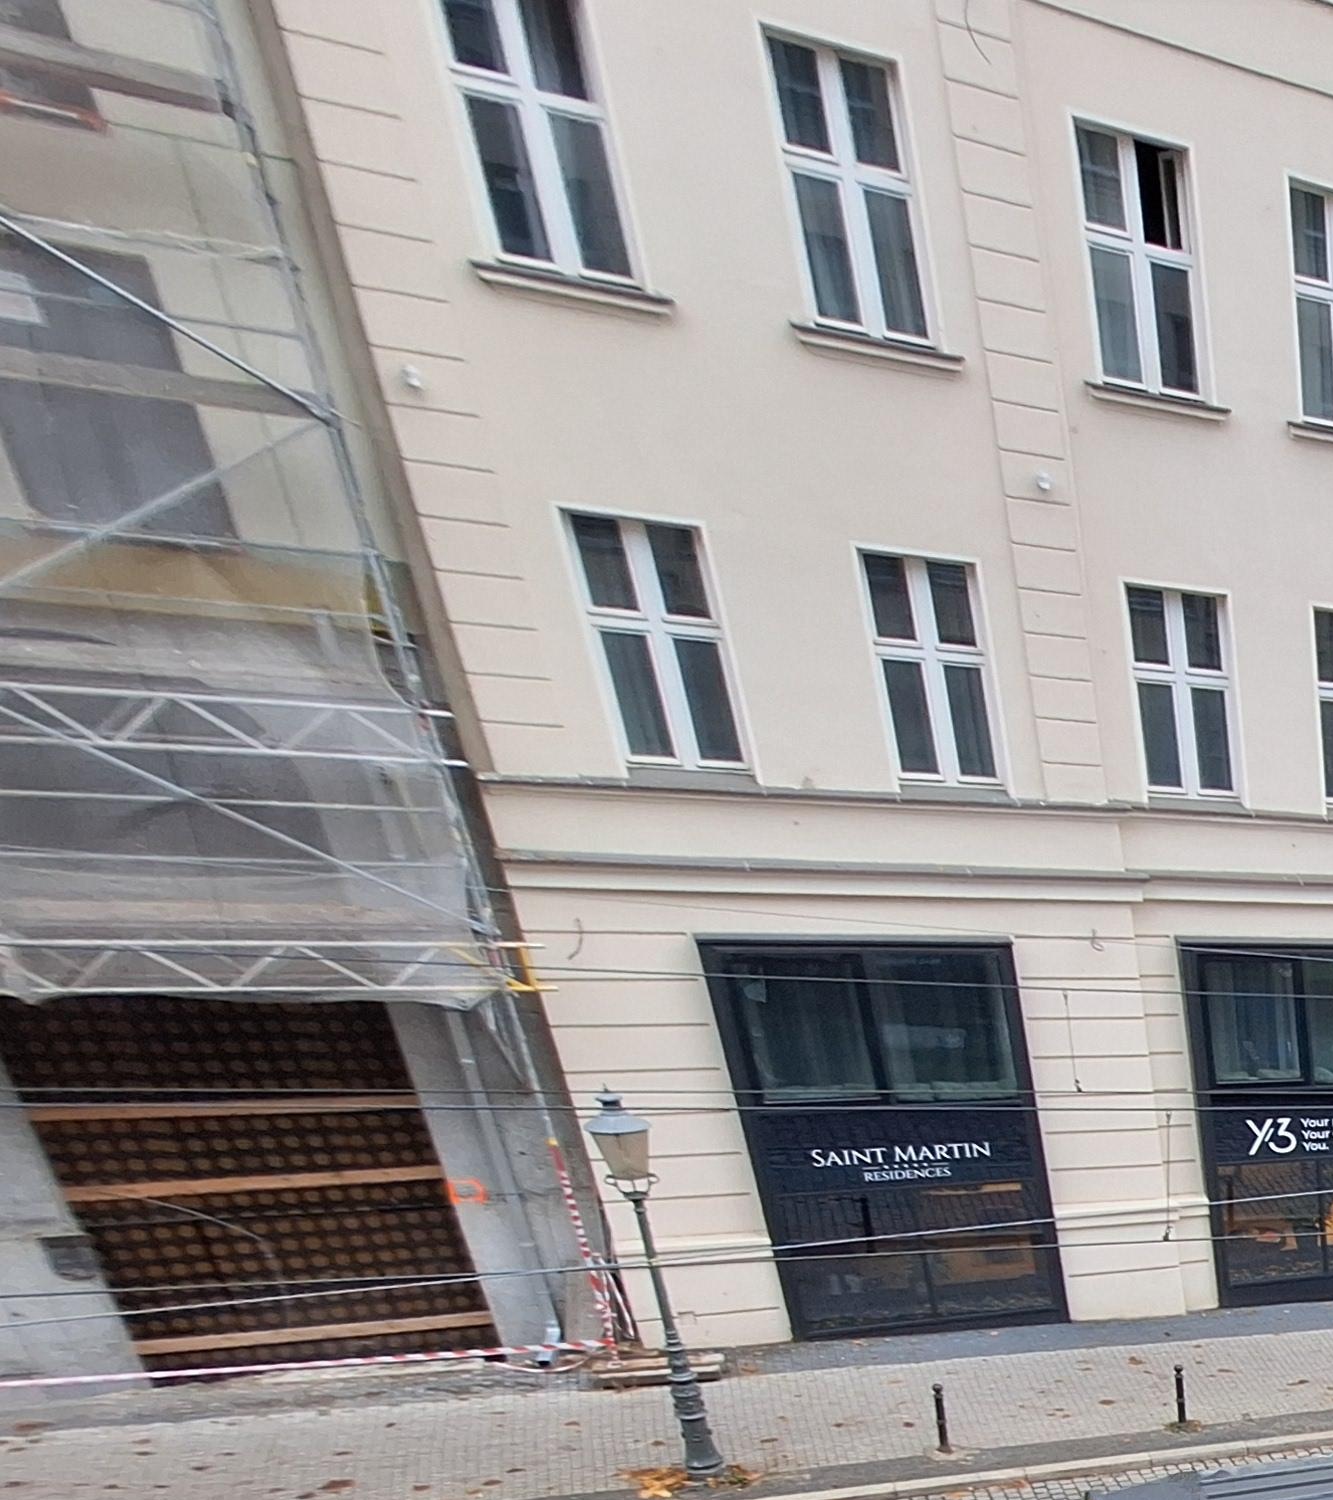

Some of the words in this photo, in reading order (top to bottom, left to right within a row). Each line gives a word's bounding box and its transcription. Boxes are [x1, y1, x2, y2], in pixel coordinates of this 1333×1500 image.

[1300, 1117, 1330, 1128] Your
[1302, 1129, 1330, 1140] Your
[1303, 1140, 1329, 1152] You.
[811, 1146, 888, 1168] SAINT
[893, 1141, 992, 1163] MARTIN
[863, 1166, 952, 1183] RESIDENCES
